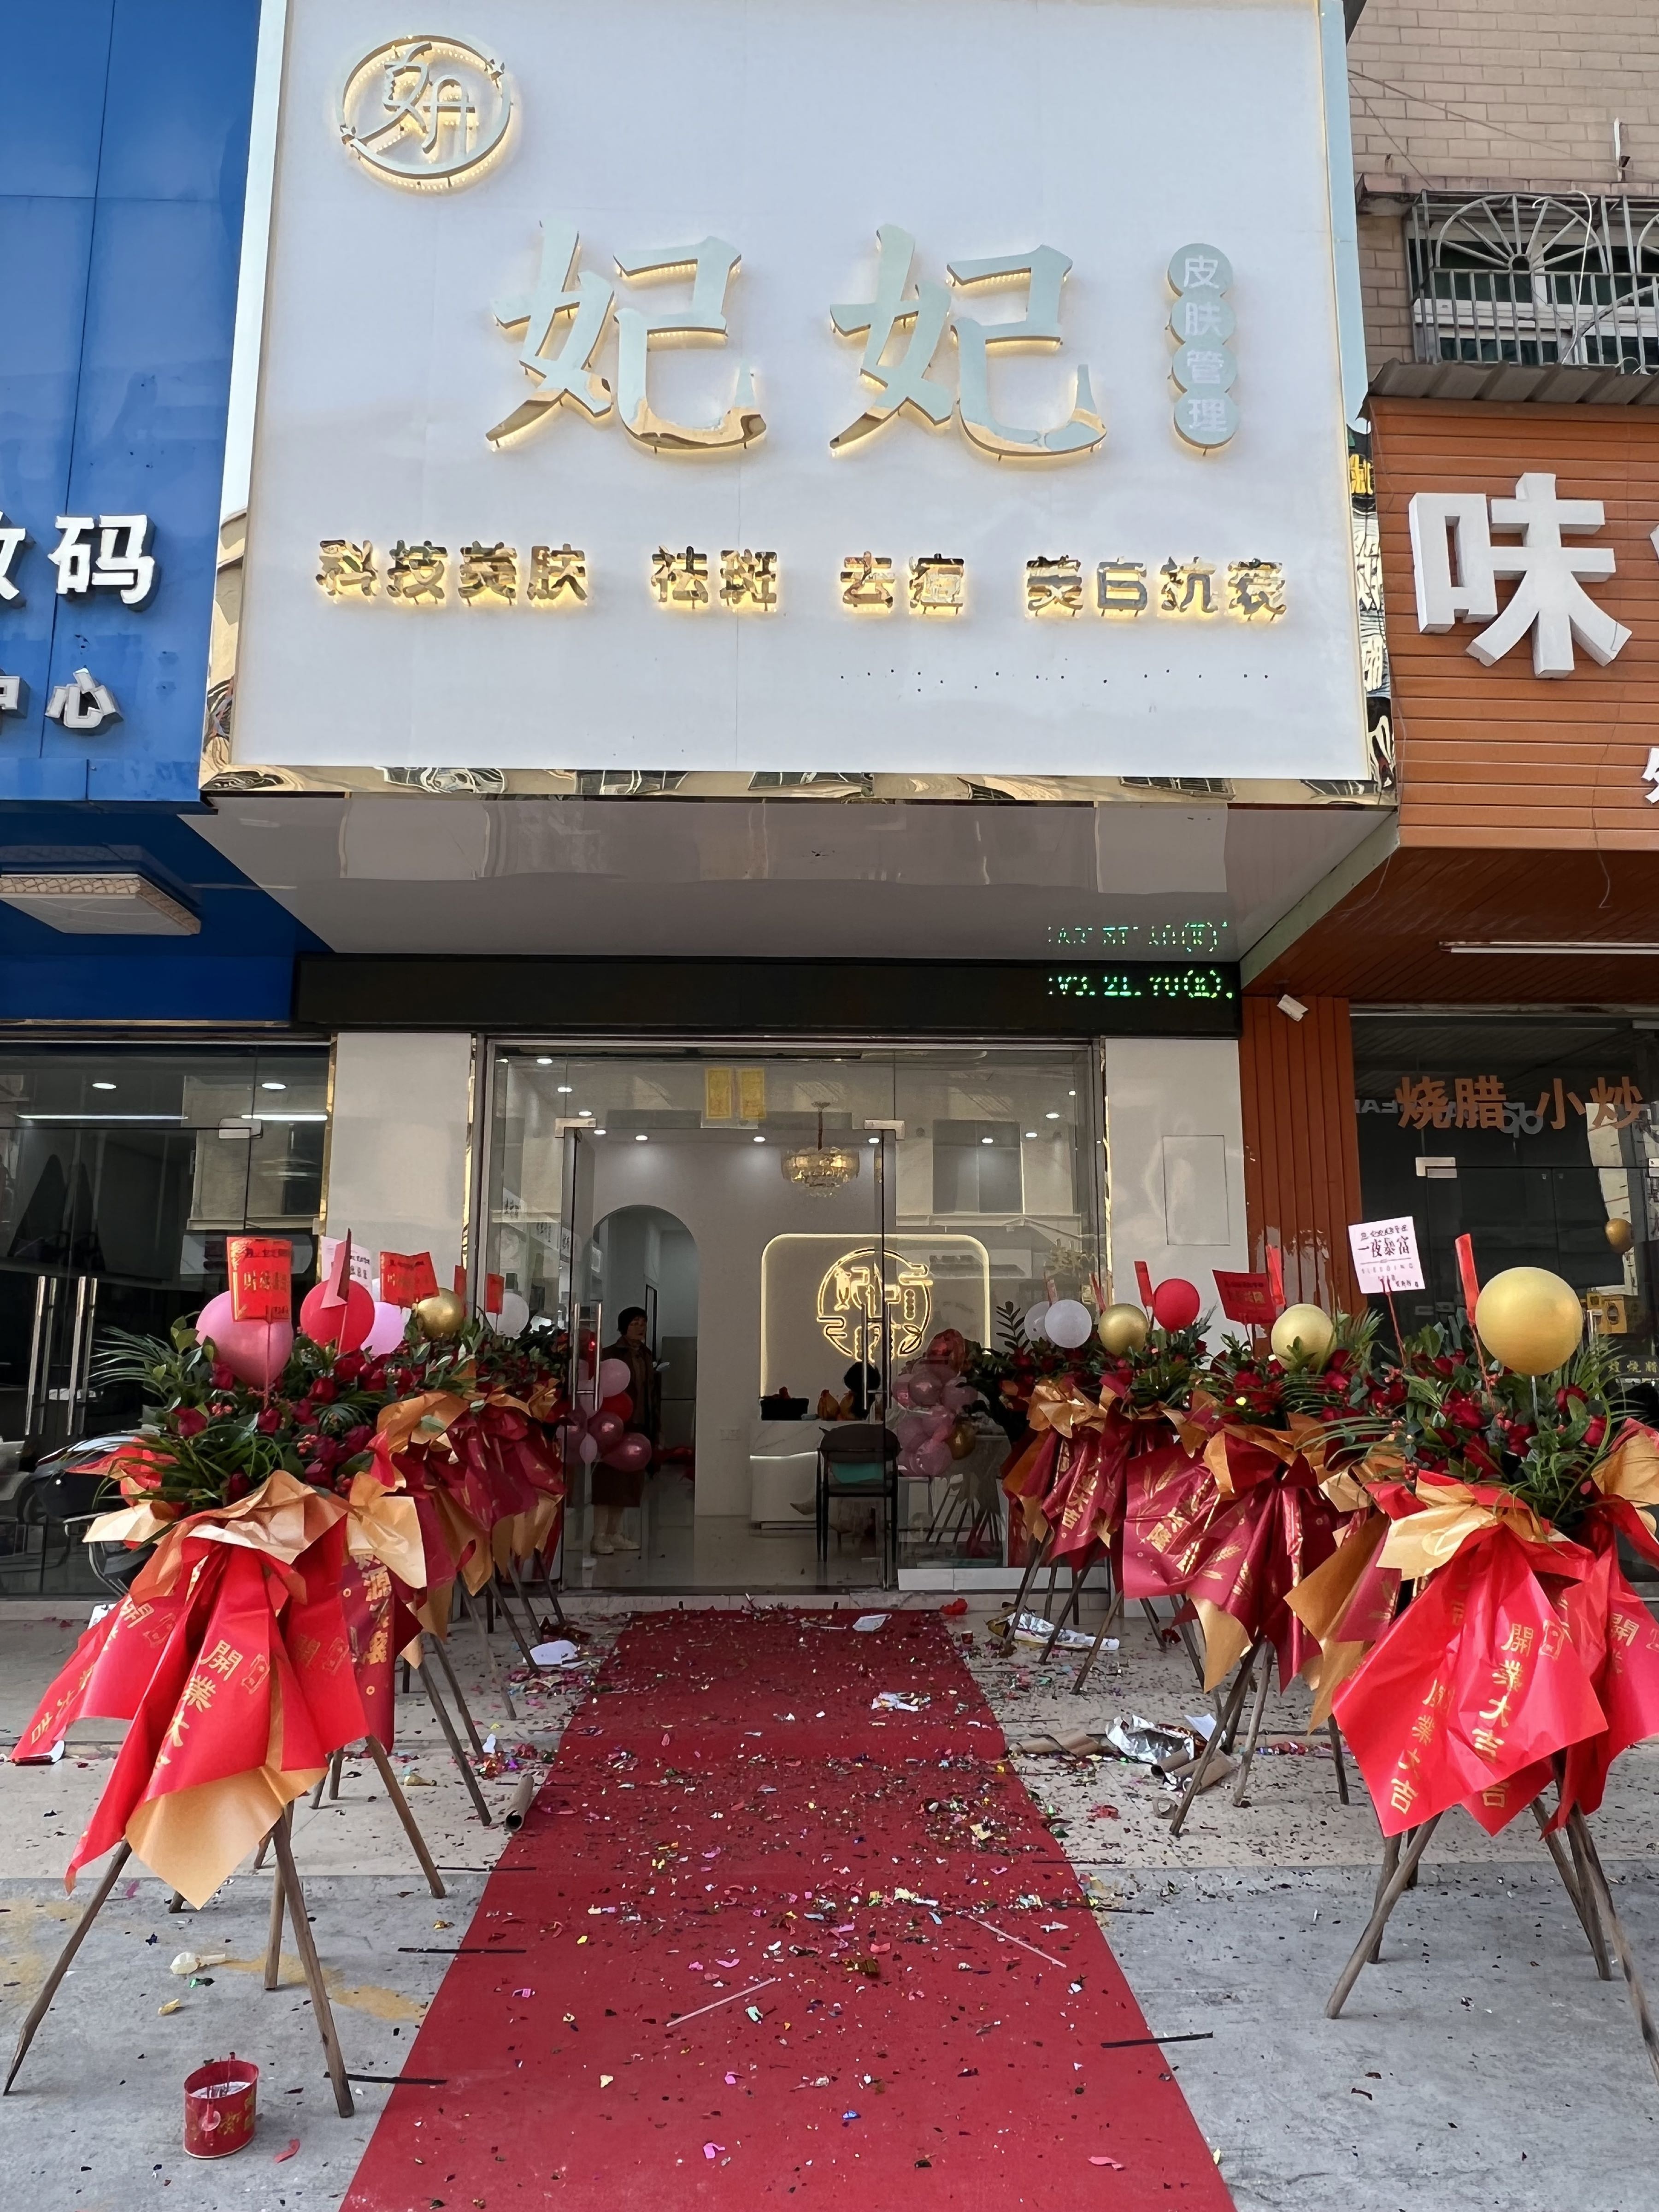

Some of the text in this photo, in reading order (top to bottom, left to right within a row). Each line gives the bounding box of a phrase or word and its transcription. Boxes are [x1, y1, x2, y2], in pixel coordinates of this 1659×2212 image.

[1183, 255, 1227, 431] 皮肤管理
[316, 539, 589, 602] 科技美肤
[651, 545, 778, 604] 祛斑
[840, 551, 964, 608] 去痘
[1026, 556, 1287, 615] 美白抗衰
[1409, 472, 1659, 680] 味
[1394, 1075, 1507, 1129] 烧腊
[1535, 1076, 1643, 1130] 小炒
